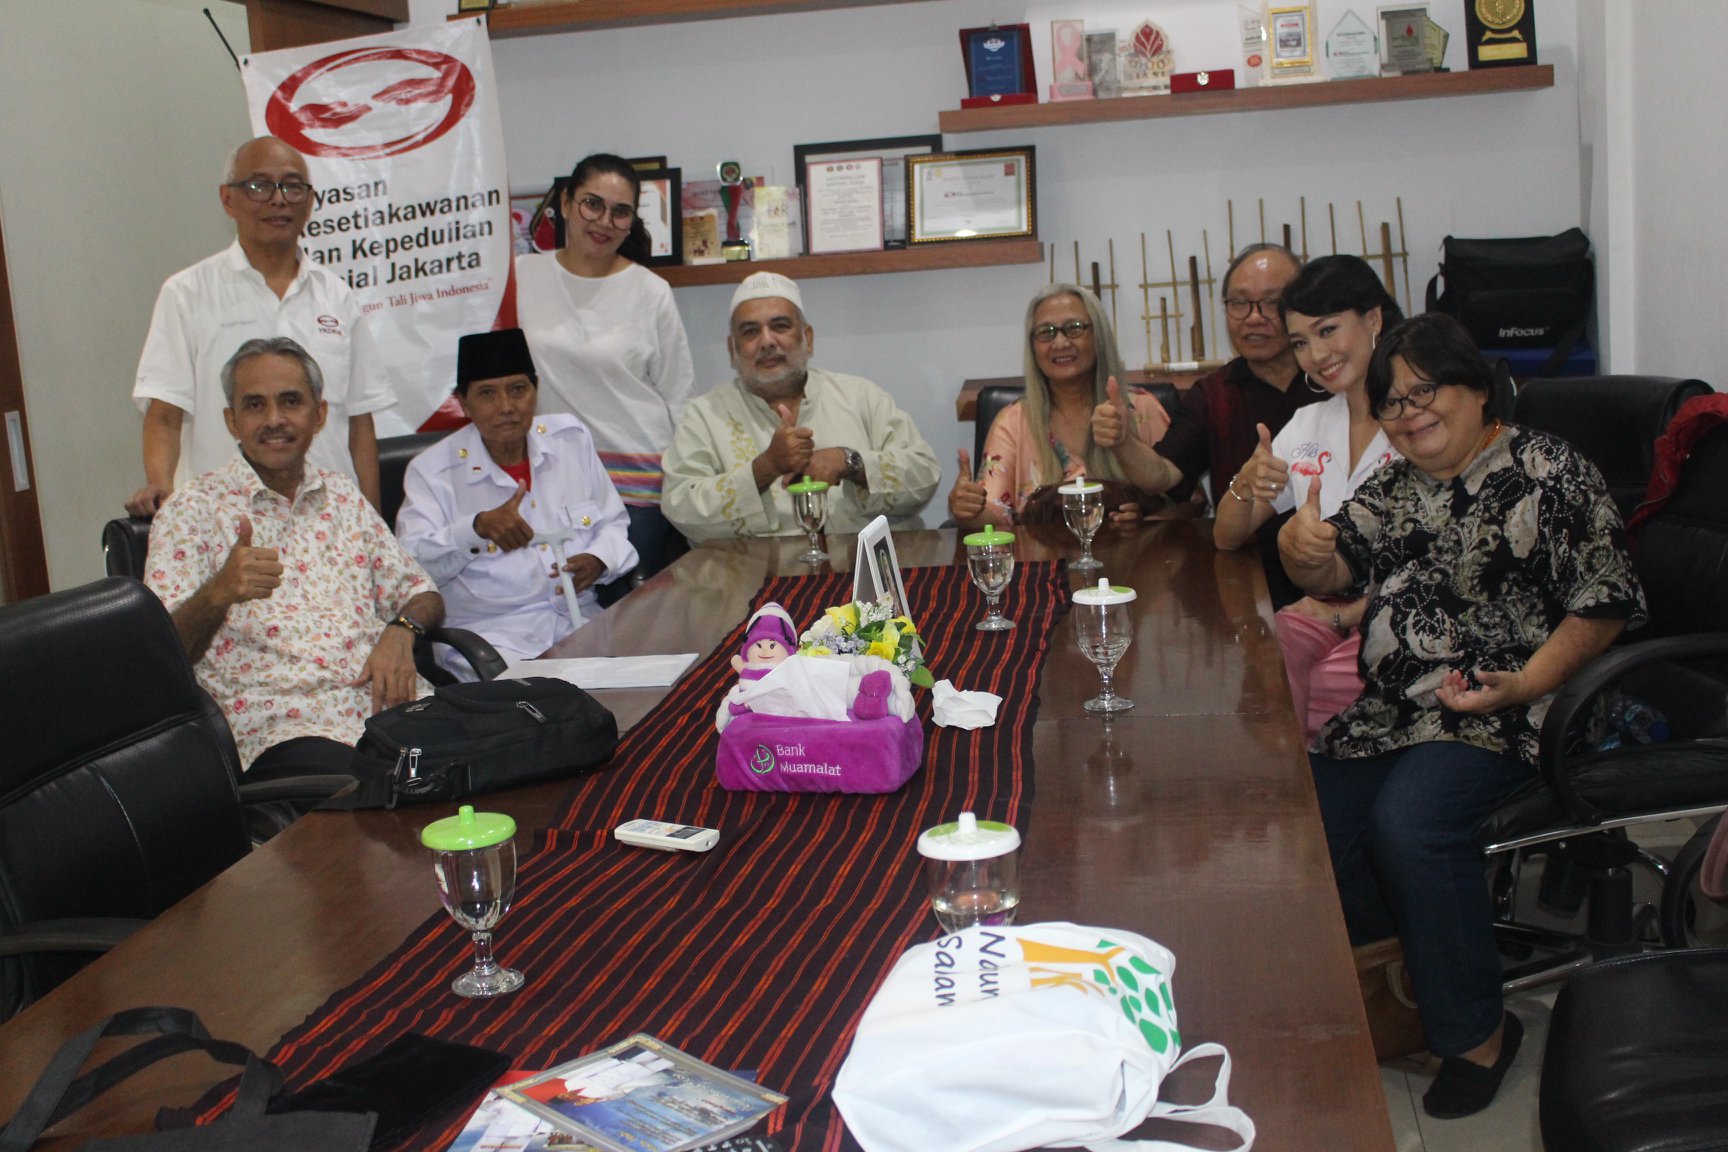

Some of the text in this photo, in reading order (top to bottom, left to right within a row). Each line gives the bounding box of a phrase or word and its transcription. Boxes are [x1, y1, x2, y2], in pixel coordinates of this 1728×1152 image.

[314, 178, 389, 210] yasan
[351, 219, 494, 260] Kepedulian
[338, 250, 482, 290] ial Jakarta
[386, 292, 408, 308] Tali
[409, 291, 434, 306] Jiwa
[1498, 326, 1545, 338] InFocus
[775, 743, 806, 757] Bank
[779, 761, 842, 777] Muamalat
